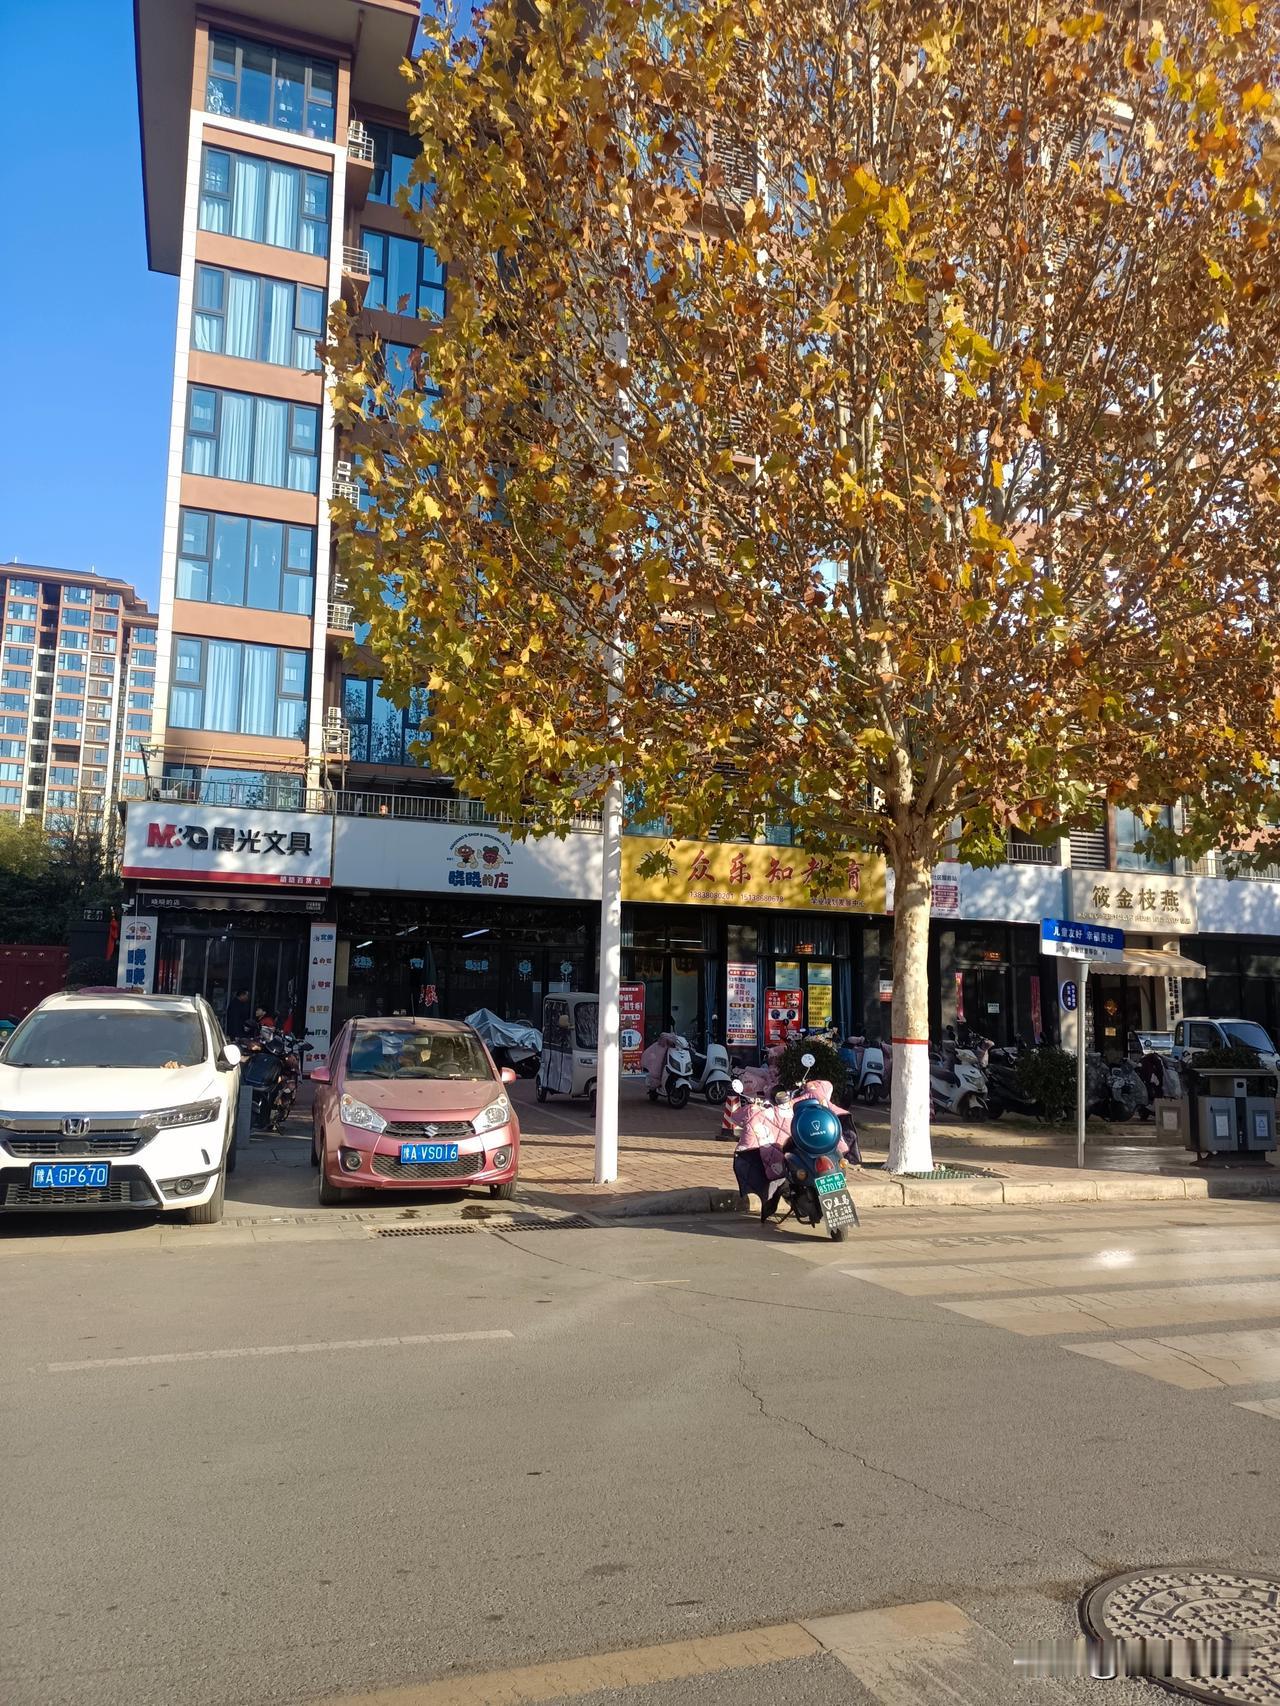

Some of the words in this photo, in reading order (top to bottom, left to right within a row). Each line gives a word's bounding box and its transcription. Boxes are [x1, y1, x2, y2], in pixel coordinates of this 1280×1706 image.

[213, 826, 312, 856] 晨光文具
[448, 870, 509, 889] 晓晓的店
[1092, 885, 1179, 912] 筱金枝燕
[1053, 926, 1082, 939] 儿童友好
[1087, 931, 1114, 943] 幸福美好
